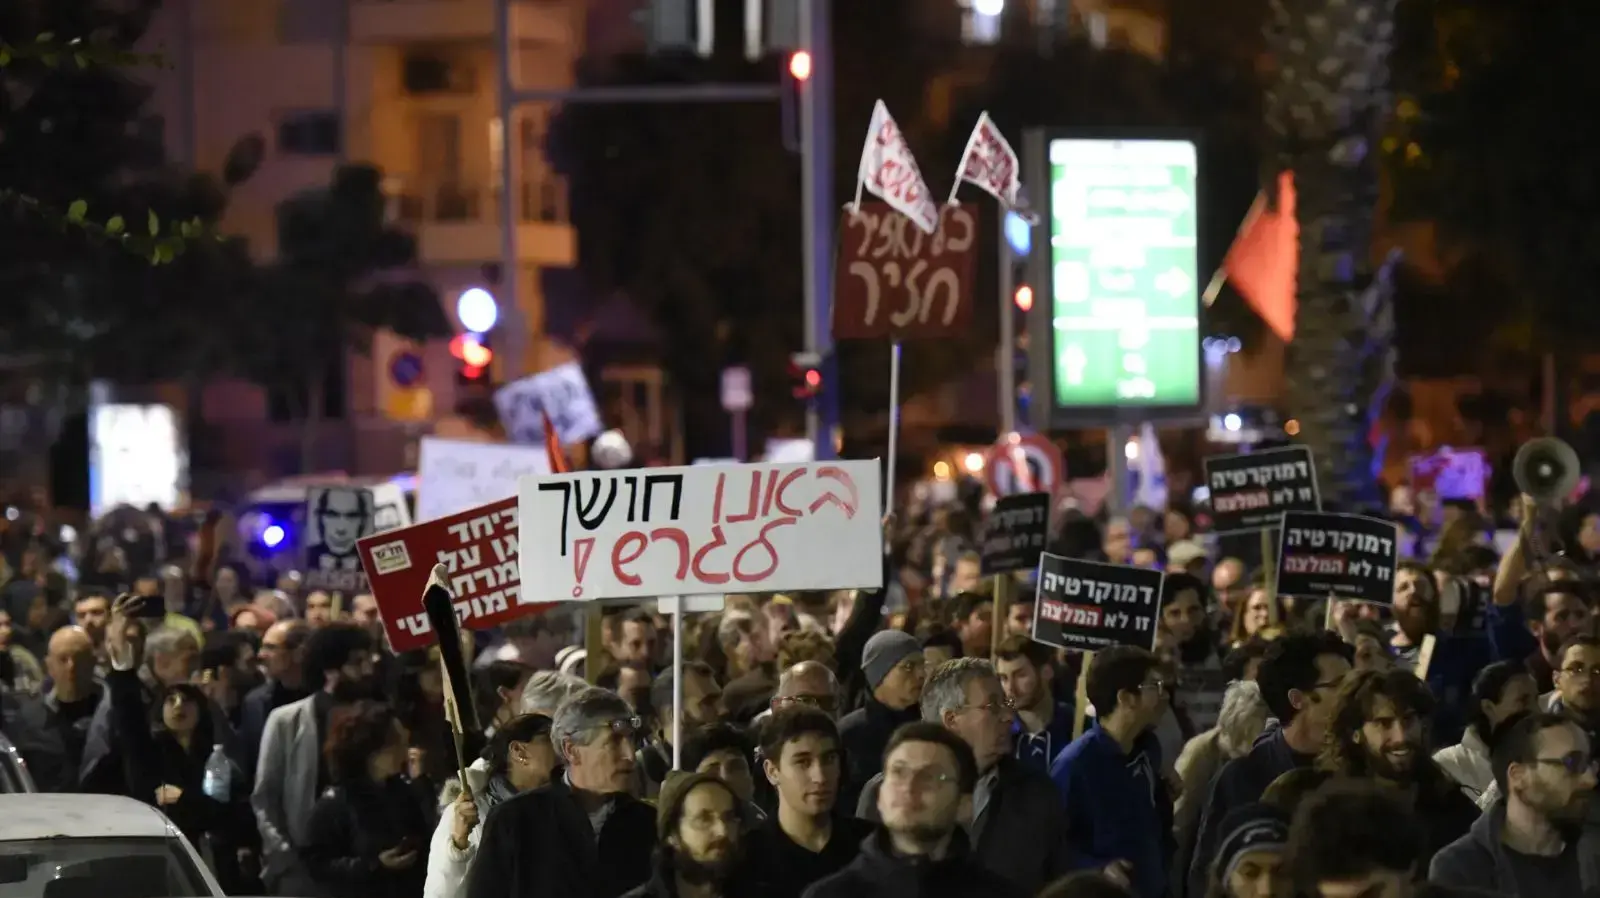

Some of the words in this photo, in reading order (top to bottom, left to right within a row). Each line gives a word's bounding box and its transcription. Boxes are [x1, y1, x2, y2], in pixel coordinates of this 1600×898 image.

[1212, 461, 1308, 488] דמוקרטיה
[712, 466, 858, 525] באנו
[1273, 486, 1294, 505] לא
[538, 474, 683, 556] חושך
[1287, 528, 1392, 556] דמוקרטיה
[1284, 555, 1344, 574] המלצה
[1348, 559, 1372, 577] לא
[1376, 565, 1391, 581] זו
[1043, 572, 1153, 605] דמוקרטיה
[1041, 602, 1099, 626] המלצה
[1104, 611, 1130, 628] לא
[1135, 616, 1150, 631] זו
